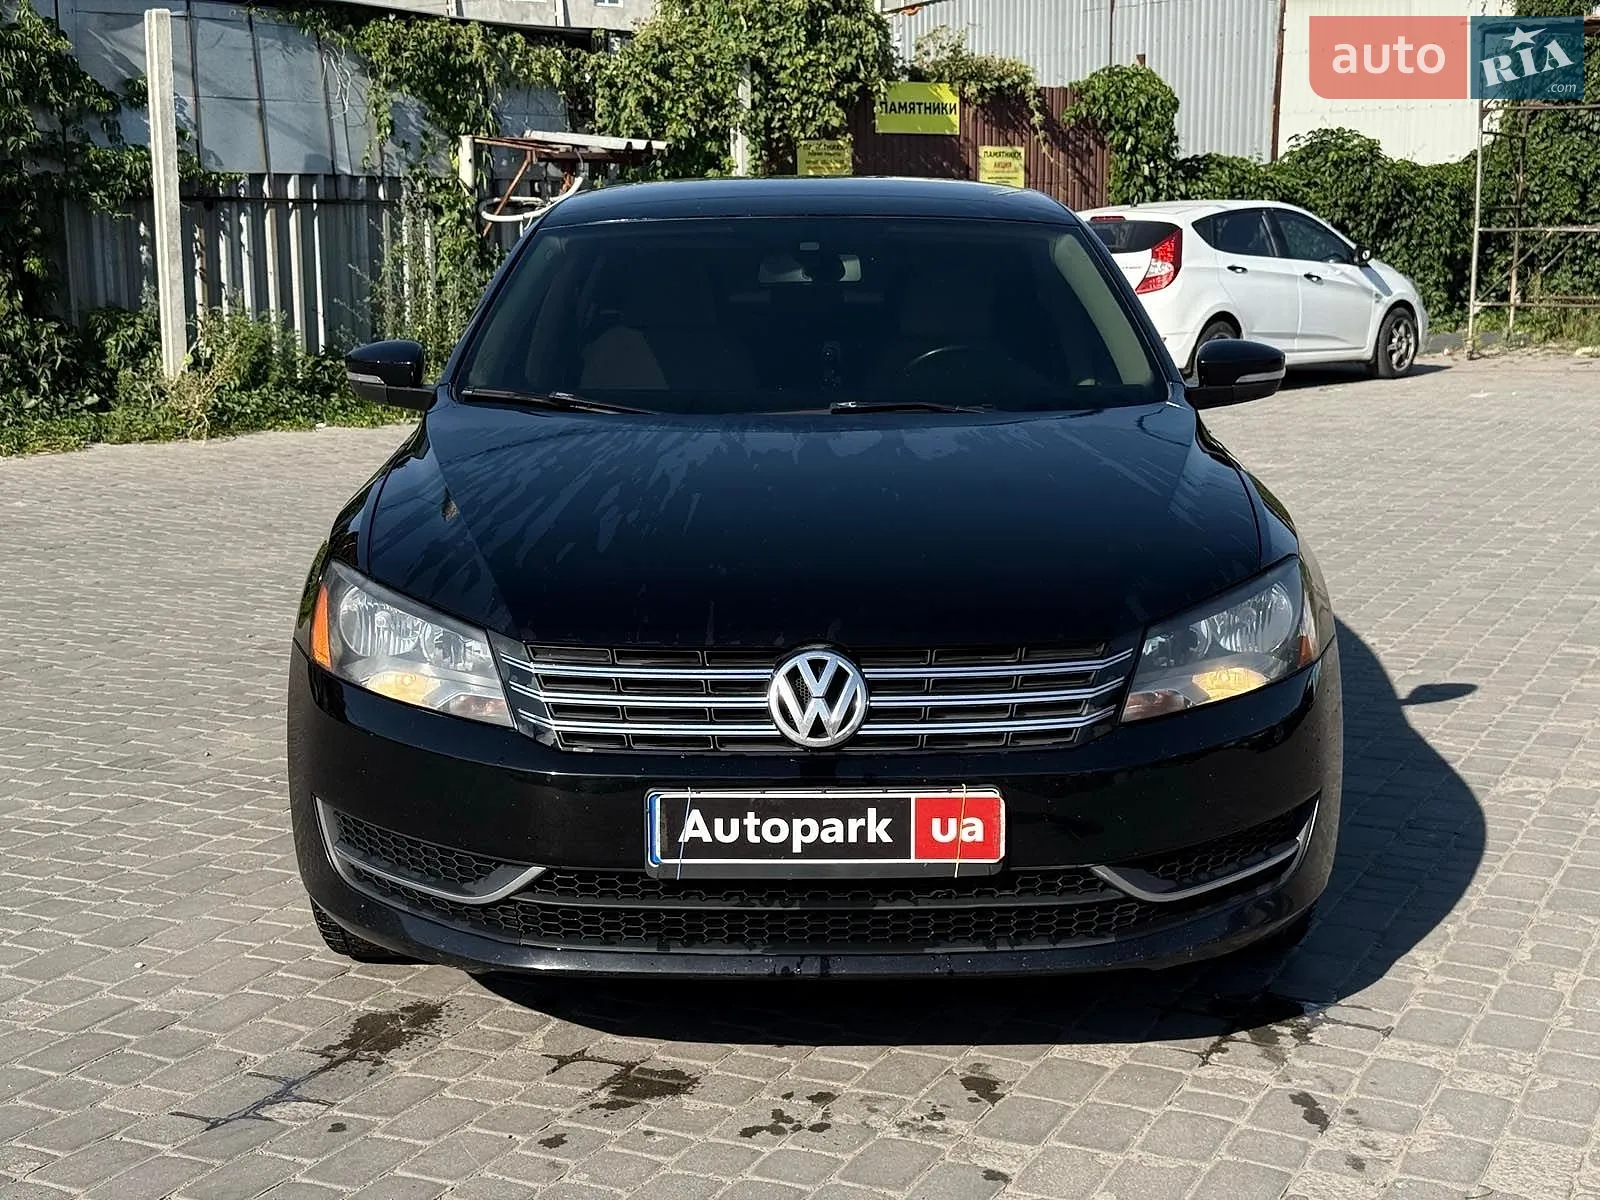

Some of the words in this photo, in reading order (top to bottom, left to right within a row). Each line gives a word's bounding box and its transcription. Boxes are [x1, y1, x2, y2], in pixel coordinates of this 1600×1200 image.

[880, 101, 957, 115] ПАМЯТНИКИ
[678, 808, 894, 853] Autopark
[930, 816, 985, 844] ua
